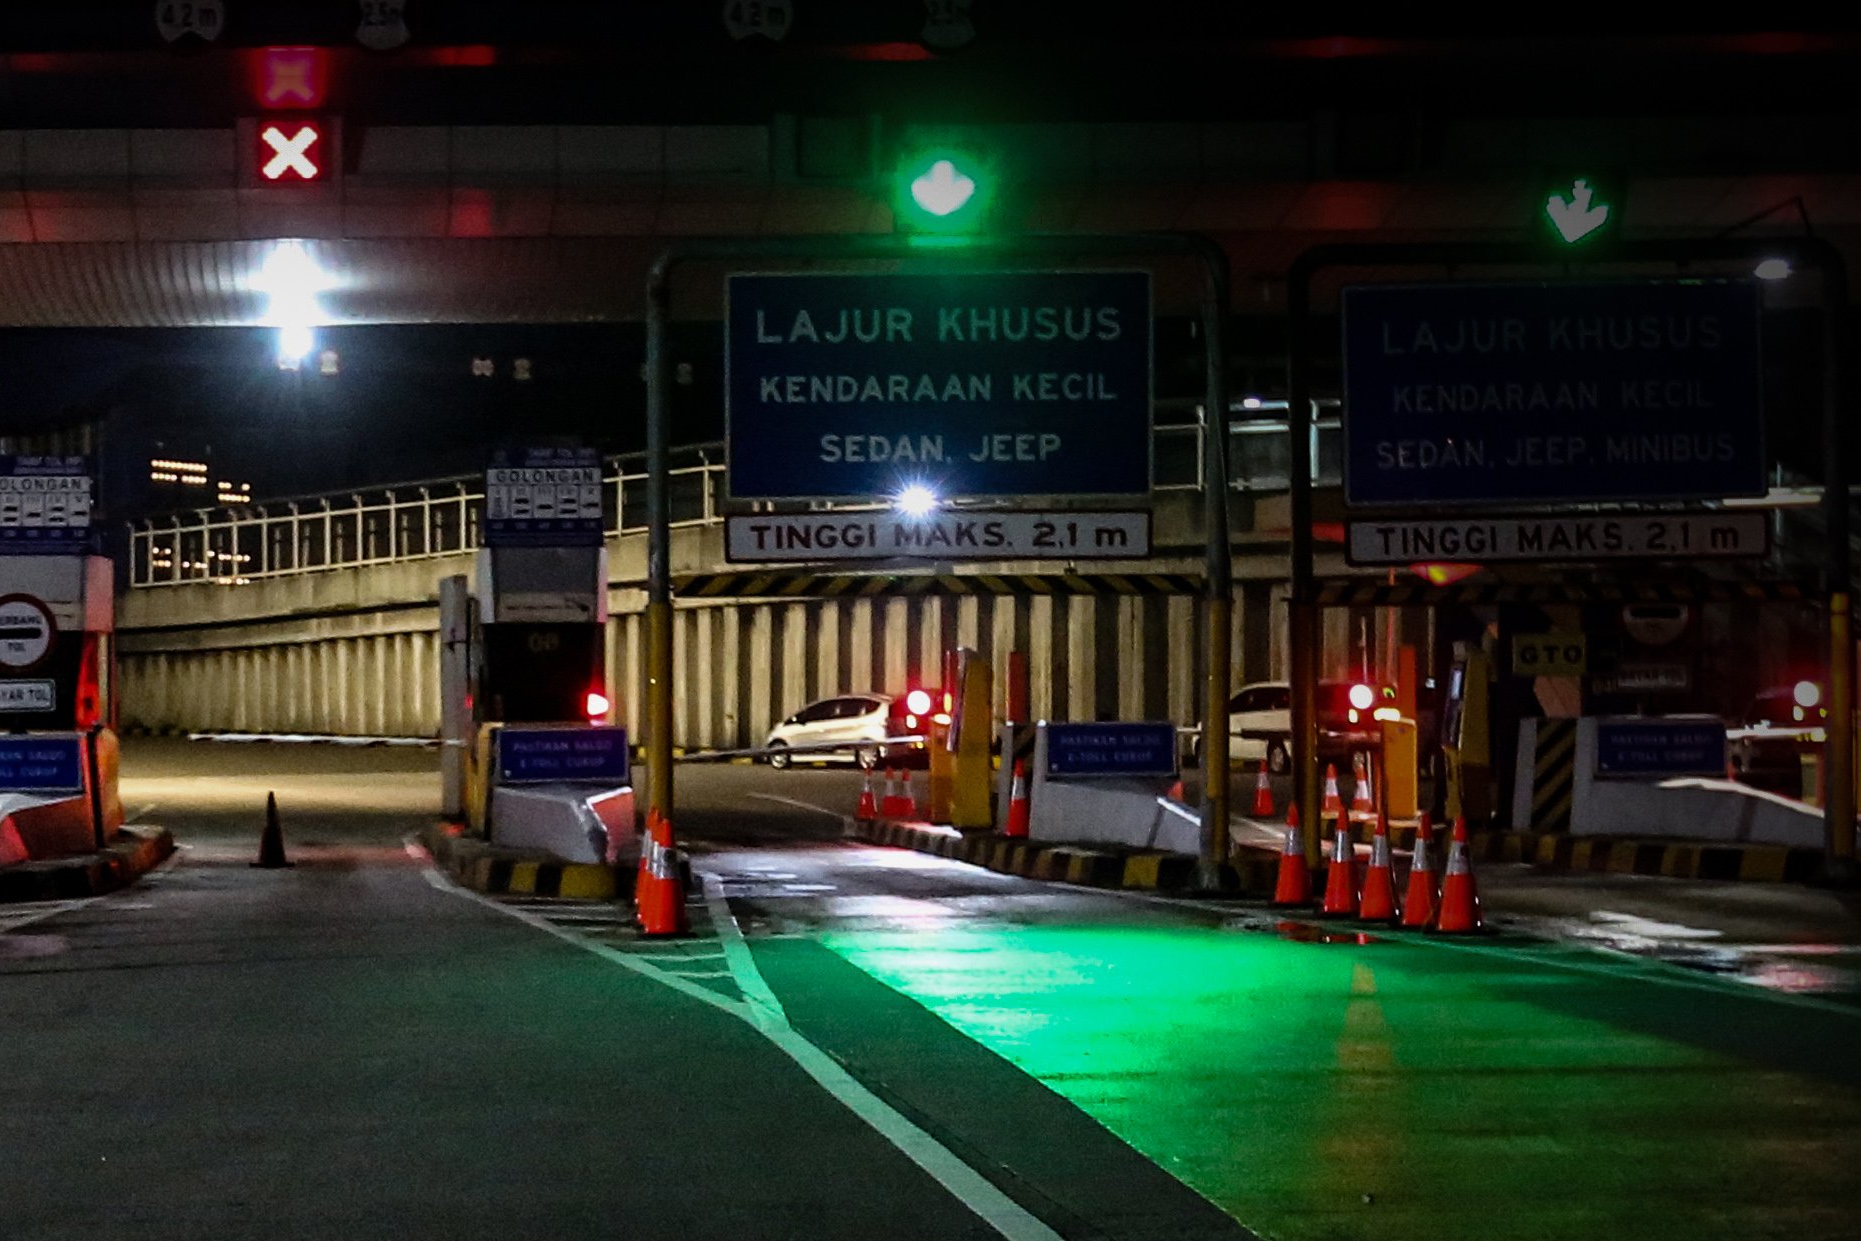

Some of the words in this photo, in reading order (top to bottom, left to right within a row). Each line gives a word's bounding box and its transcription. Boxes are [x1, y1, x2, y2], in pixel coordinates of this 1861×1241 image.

[755, 308, 915, 345] LAJUR
[937, 306, 1123, 344] KHUSUS
[1382, 318, 1527, 356] LAJUR
[1547, 315, 1723, 353] KHUSUS
[759, 373, 993, 404] KENDARAAN
[1012, 372, 1118, 402] KECIL
[1392, 381, 1599, 414] KENDARAAN
[1621, 377, 1715, 410] KECIL
[969, 433, 1063, 463] JEEP
[1607, 433, 1739, 465] MINIBUS
[496, 470, 593, 482] GOLONGAN
[750, 524, 877, 549] TINGGI
[893, 523, 1014, 549] MAKS.
[1095, 527, 1128, 547] m
[1377, 525, 1498, 556] TINGGI
[1517, 524, 1635, 553] MAKS.
[1711, 526, 1739, 548] m
[7, 641, 26, 652] TOL
[1520, 644, 1582, 664] GTO
